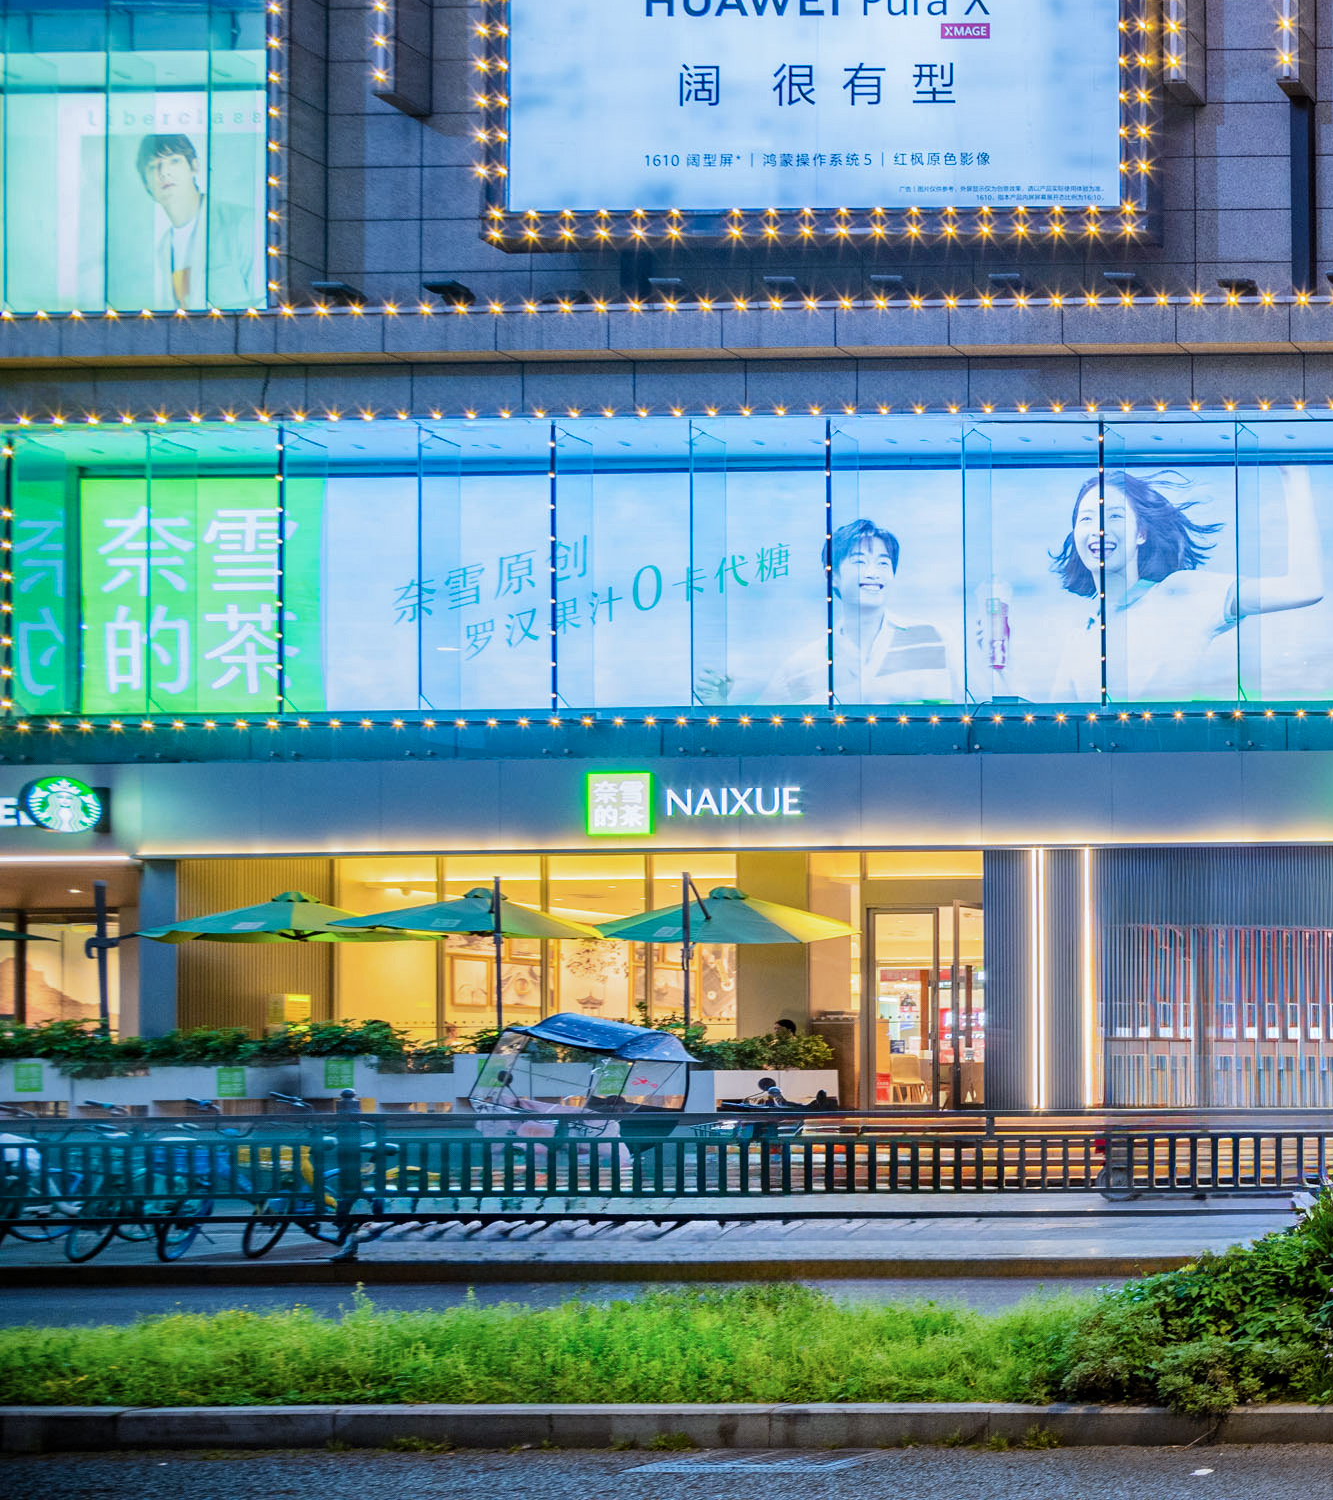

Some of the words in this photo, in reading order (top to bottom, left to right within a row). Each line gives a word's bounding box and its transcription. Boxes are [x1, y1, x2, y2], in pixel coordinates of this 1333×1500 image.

[943, 25, 988, 38] XMAGE
[644, 153, 680, 168] 1610
[893, 150, 992, 167] 红枫原色影像
[97, 505, 300, 598] 奈雪
[393, 534, 588, 626] 奈雪原创
[98, 604, 300, 695] 的茶
[593, 780, 645, 804] 奈雪
[665, 787, 803, 817] NAIXUE
[593, 805, 645, 828] 的茶
